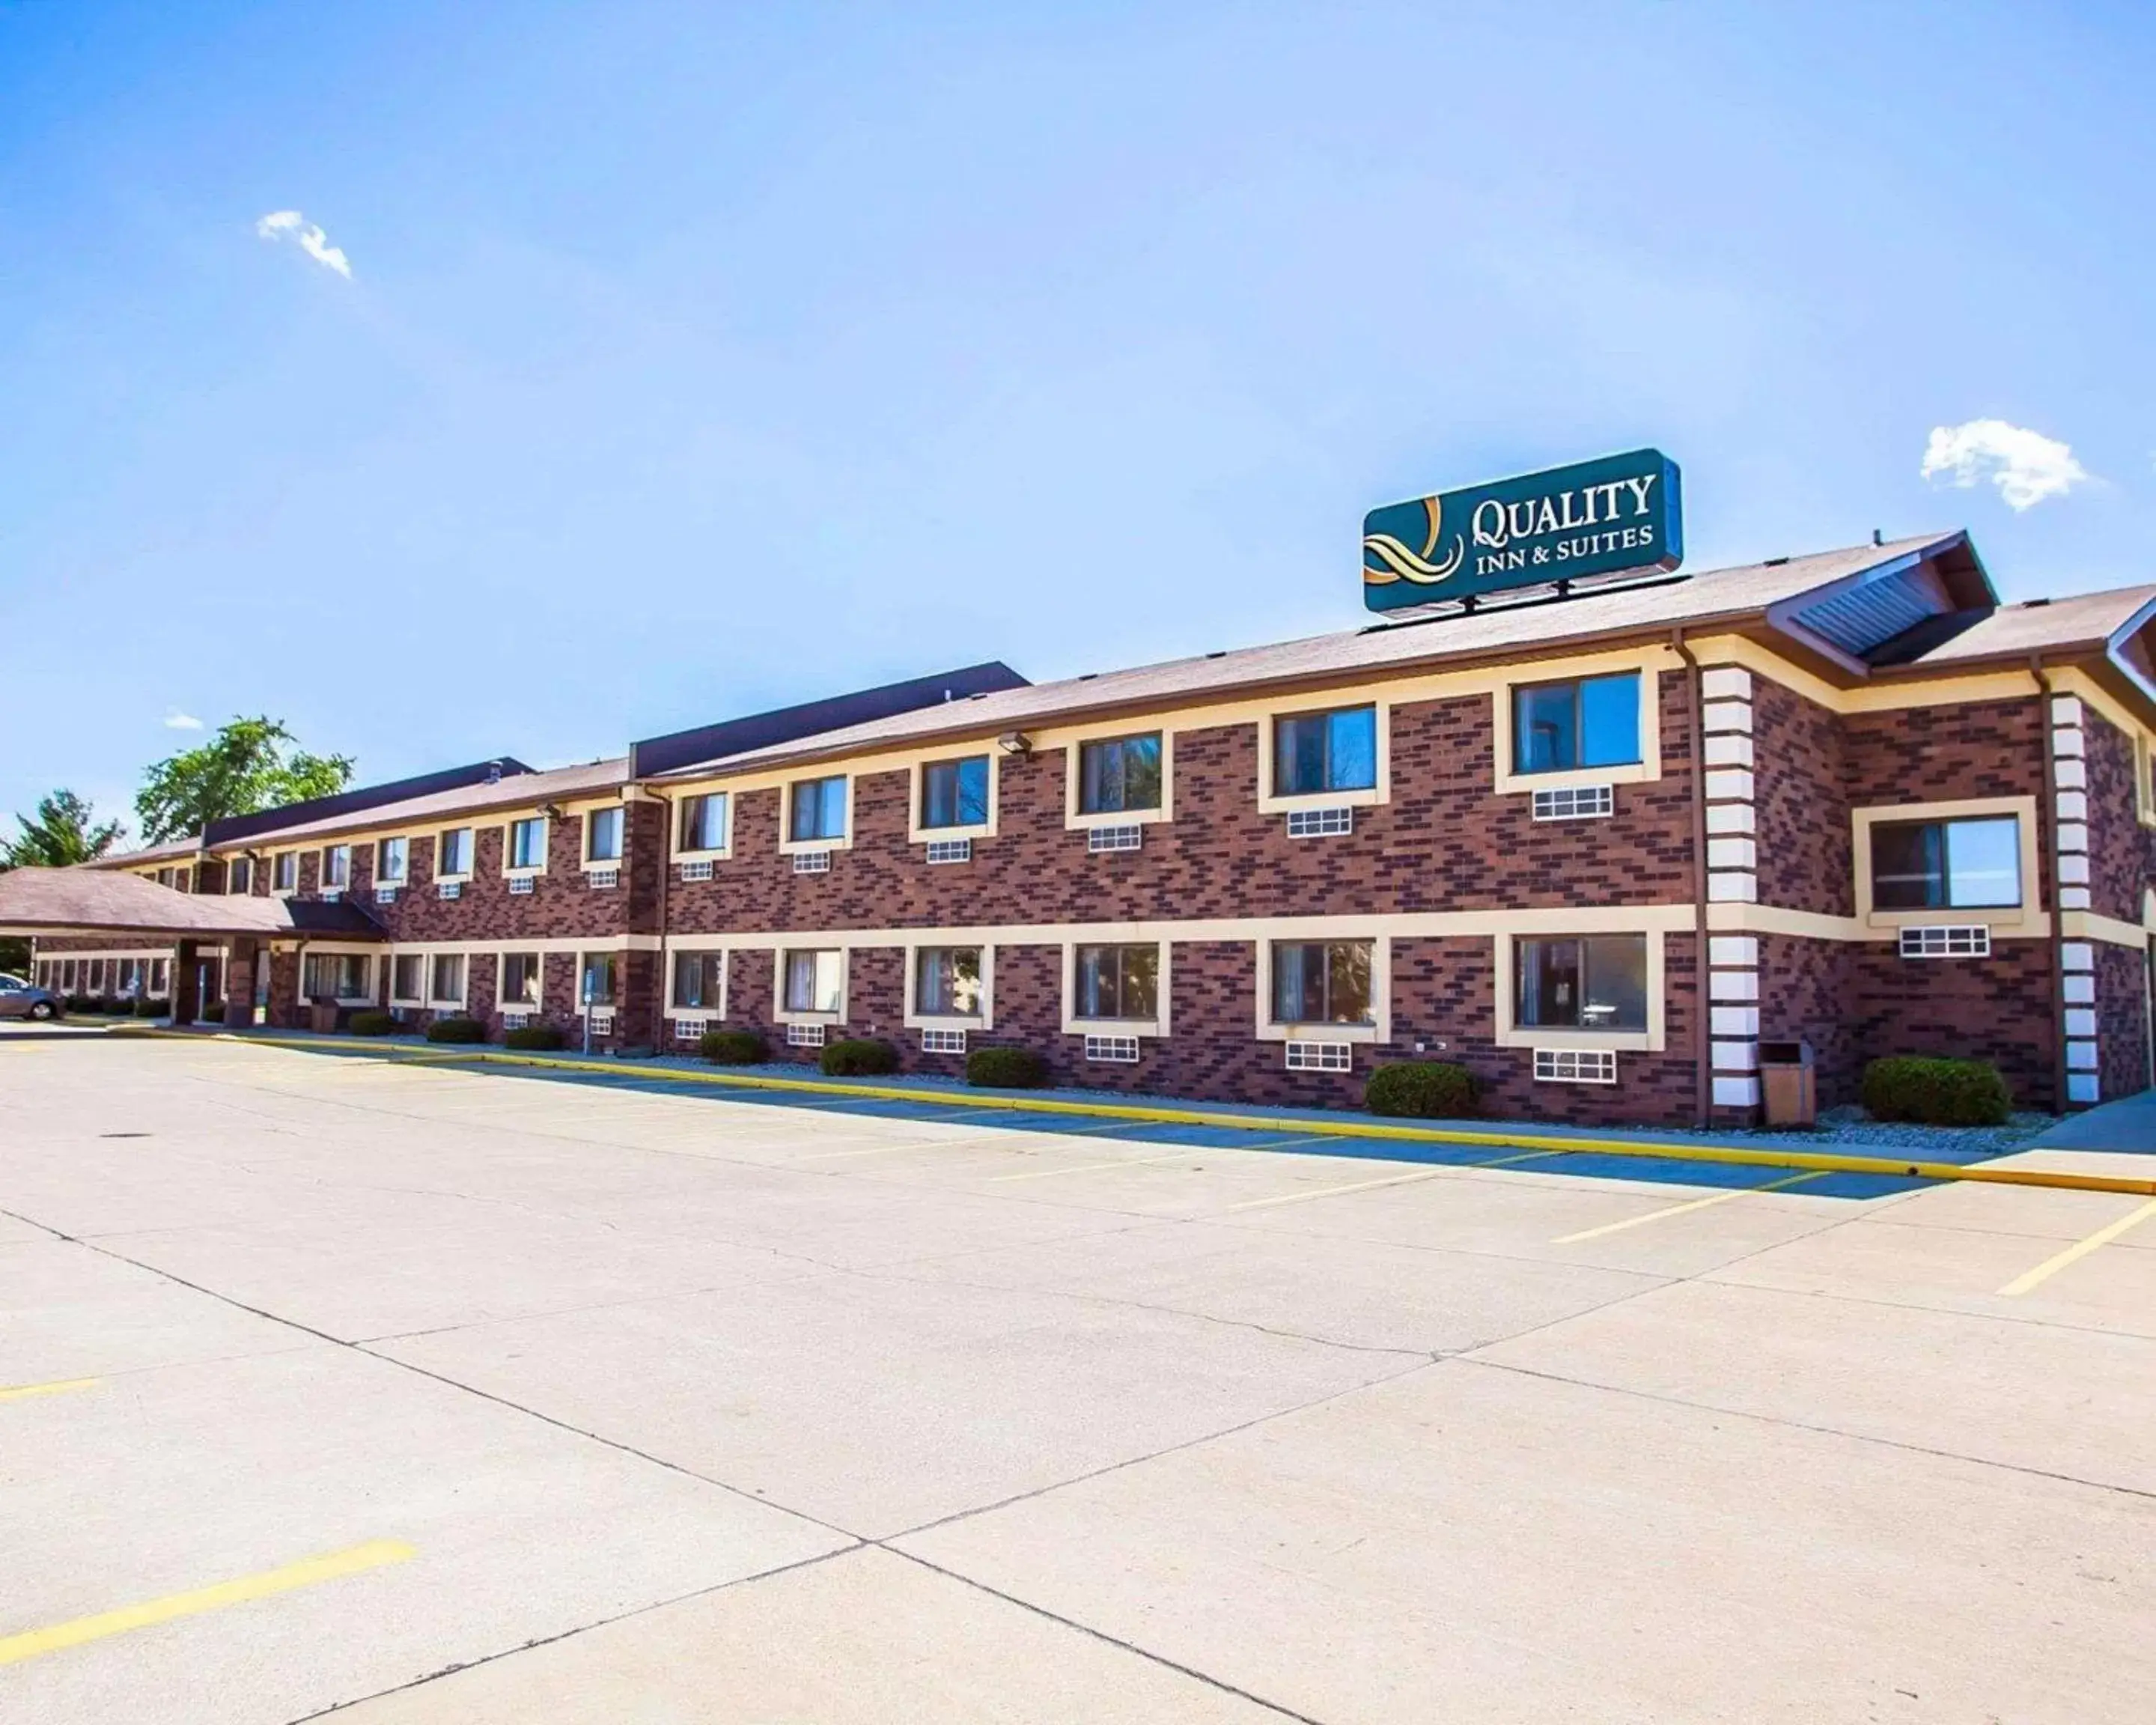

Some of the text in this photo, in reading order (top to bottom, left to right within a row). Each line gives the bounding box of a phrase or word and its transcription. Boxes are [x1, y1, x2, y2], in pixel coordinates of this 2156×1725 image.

[1473, 474, 1657, 548] QUALITY
[1476, 525, 1654, 576] INN & SUITES
